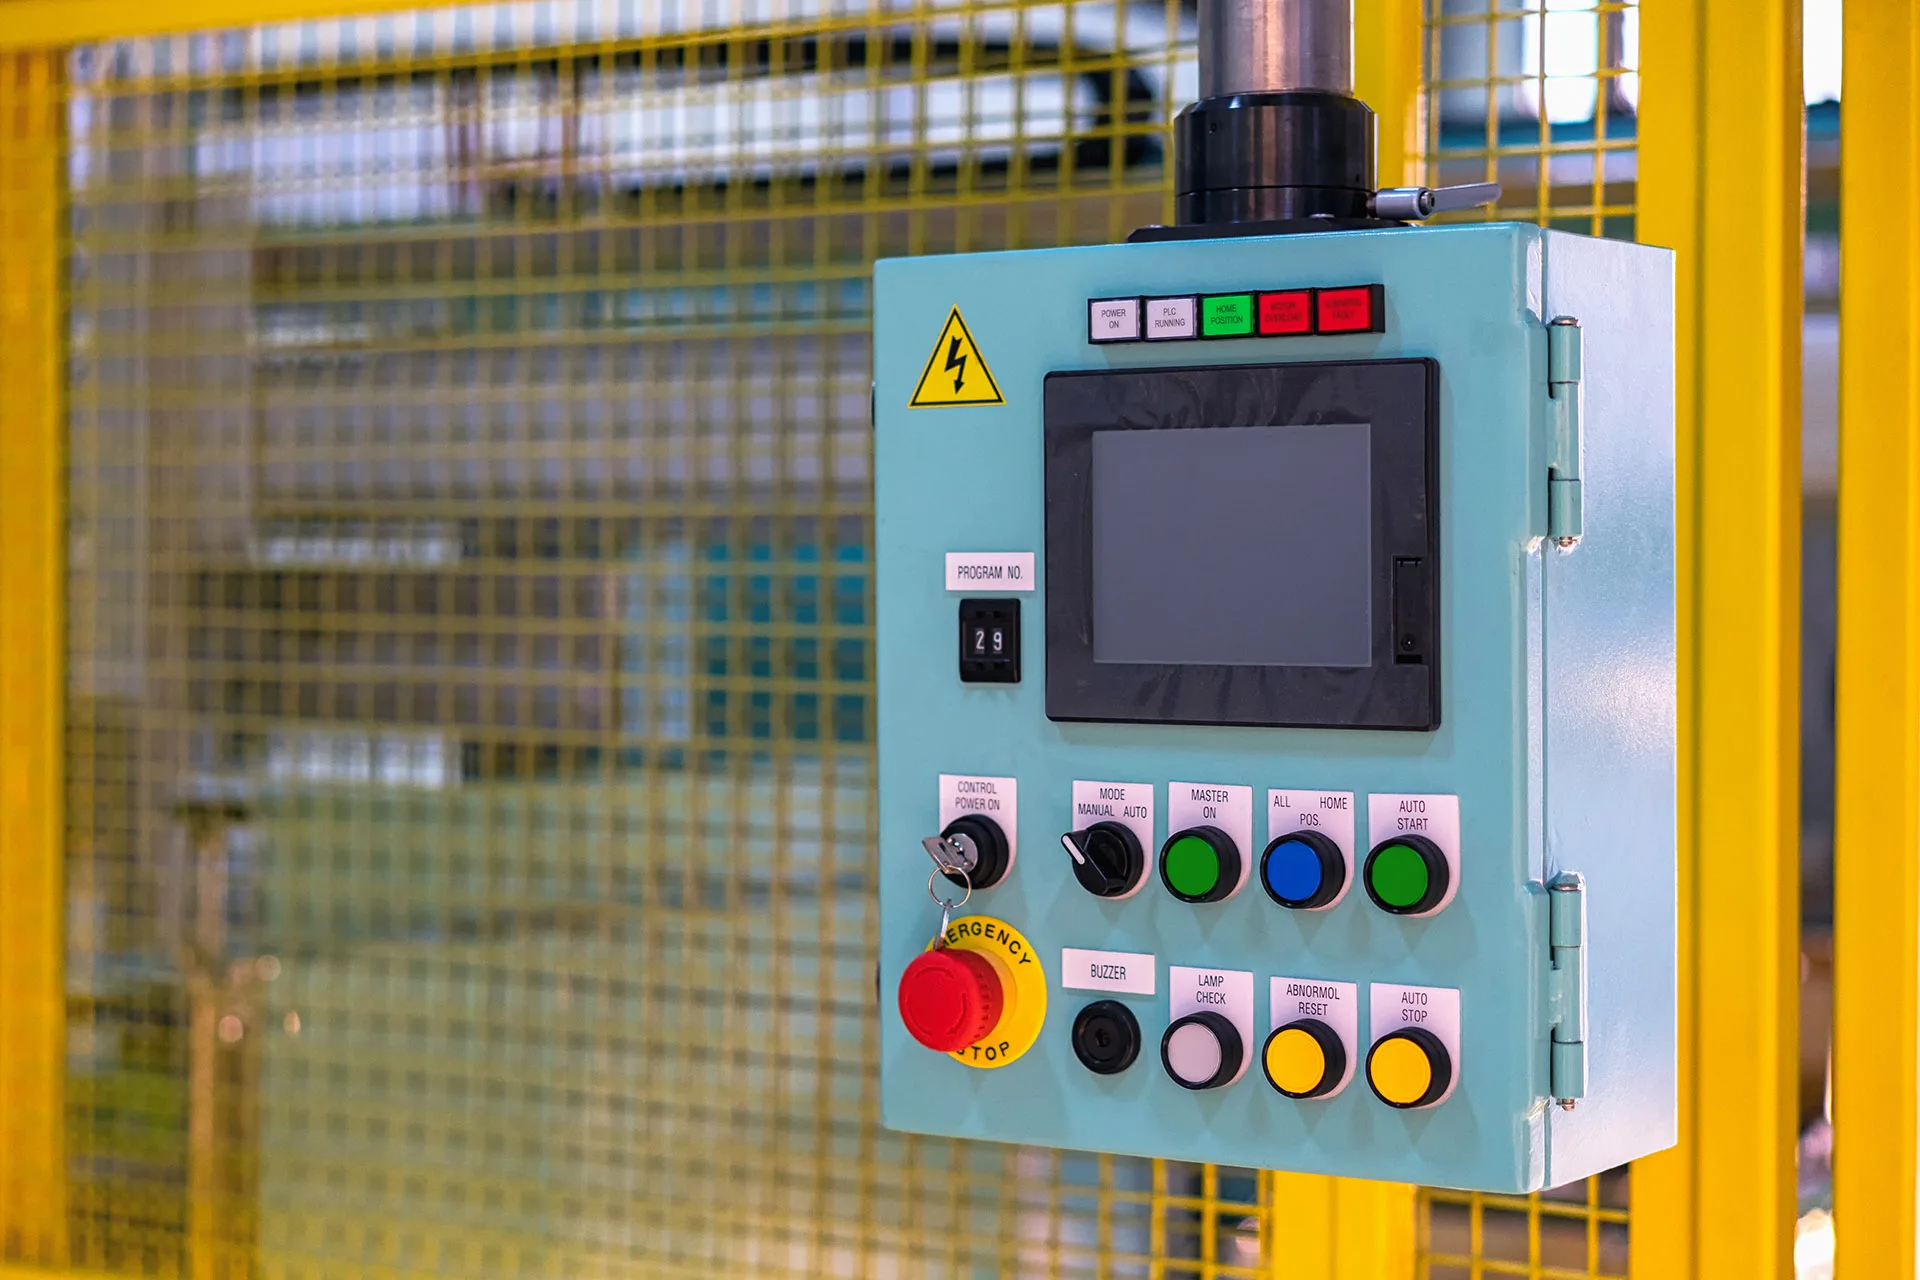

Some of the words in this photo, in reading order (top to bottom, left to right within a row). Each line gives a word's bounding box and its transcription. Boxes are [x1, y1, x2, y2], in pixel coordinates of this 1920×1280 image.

[1101, 308, 1127, 318] POWER
[1162, 307, 1177, 316] PLC
[1215, 303, 1237, 314] HOME
[1108, 320, 1120, 329] ON
[1153, 317, 1187, 329] RUNNING
[1210, 314, 1244, 326] POSITION
[957, 565, 1003, 580] PROGRAM
[1007, 565, 1024, 580] NO.
[957, 780, 998, 795] CONTROL
[1099, 787, 1125, 801] MODE
[1191, 788, 1229, 803] MASTER
[1273, 795, 1291, 808] ALL
[1319, 796, 1348, 810] HOME
[955, 796, 986, 811] POWER
[987, 798, 1001, 811] ON
[1077, 802, 1116, 817] MANUAL
[1122, 805, 1148, 819] AUTO
[1399, 800, 1426, 814] AUTO
[1202, 806, 1217, 819] ON
[1299, 813, 1322, 827] POS.
[1397, 817, 1429, 831] START
[942, 921, 1032, 965] ERGENCY
[1090, 963, 1127, 980] BUZZER
[1198, 974, 1225, 988] LAMP
[1196, 990, 1227, 1005] CHECK
[1285, 982, 1341, 1001] ABNORMOL
[1401, 991, 1428, 1006] AUTO
[1298, 1001, 1328, 1016] RESET
[1401, 1008, 1428, 1023] STOP
